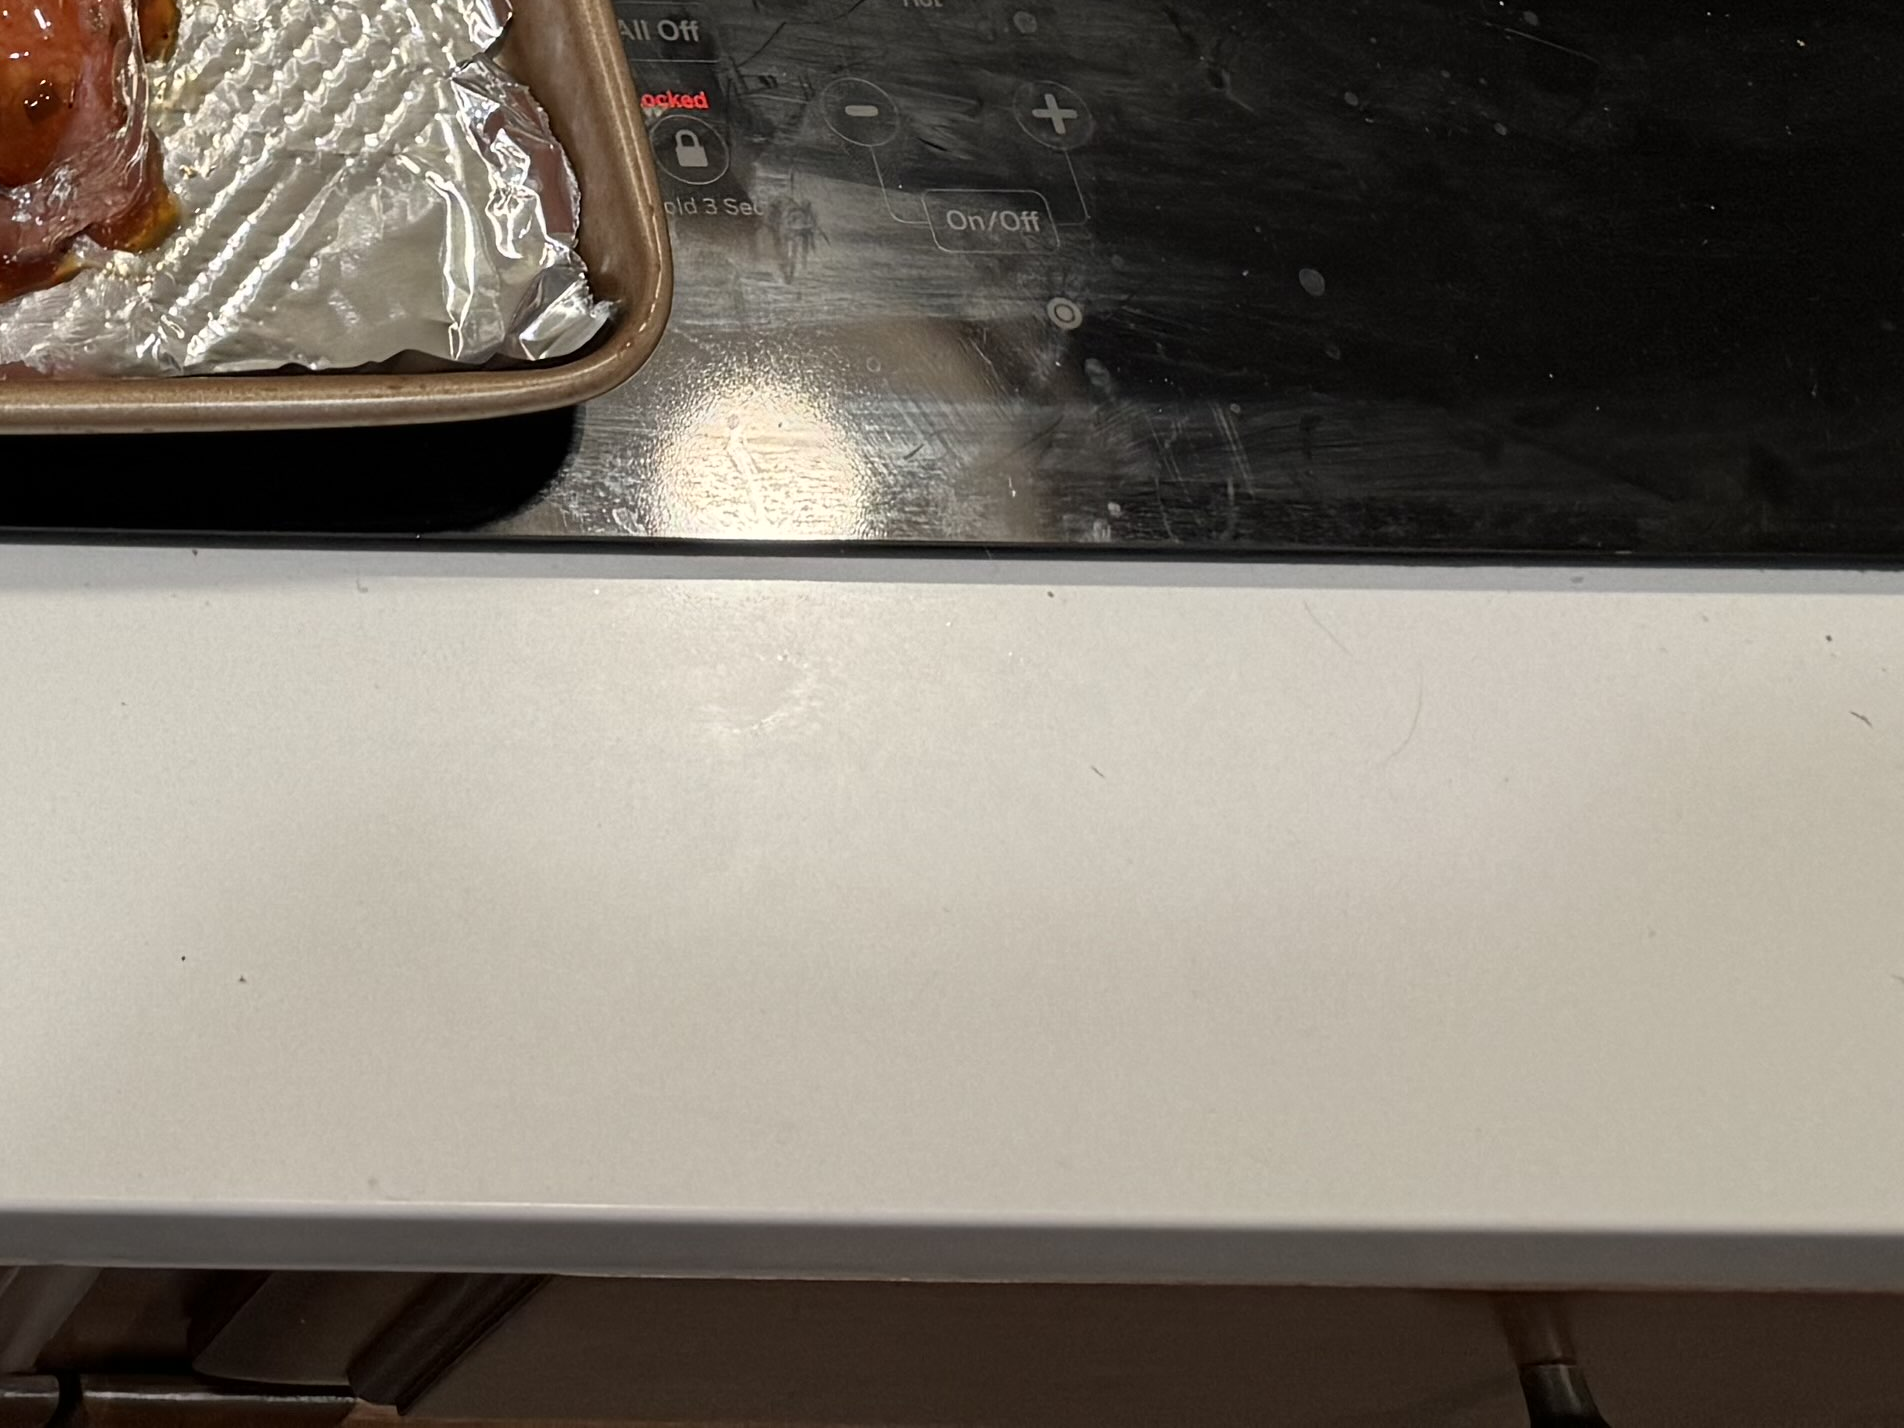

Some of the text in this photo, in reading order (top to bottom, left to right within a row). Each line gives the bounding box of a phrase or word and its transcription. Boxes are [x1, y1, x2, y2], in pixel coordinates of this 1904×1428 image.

[616, 19, 700, 42] All Off
[640, 89, 710, 110] ocked
[663, 197, 698, 215] old
[702, 197, 718, 215] 3
[945, 209, 1042, 234] On/Off
